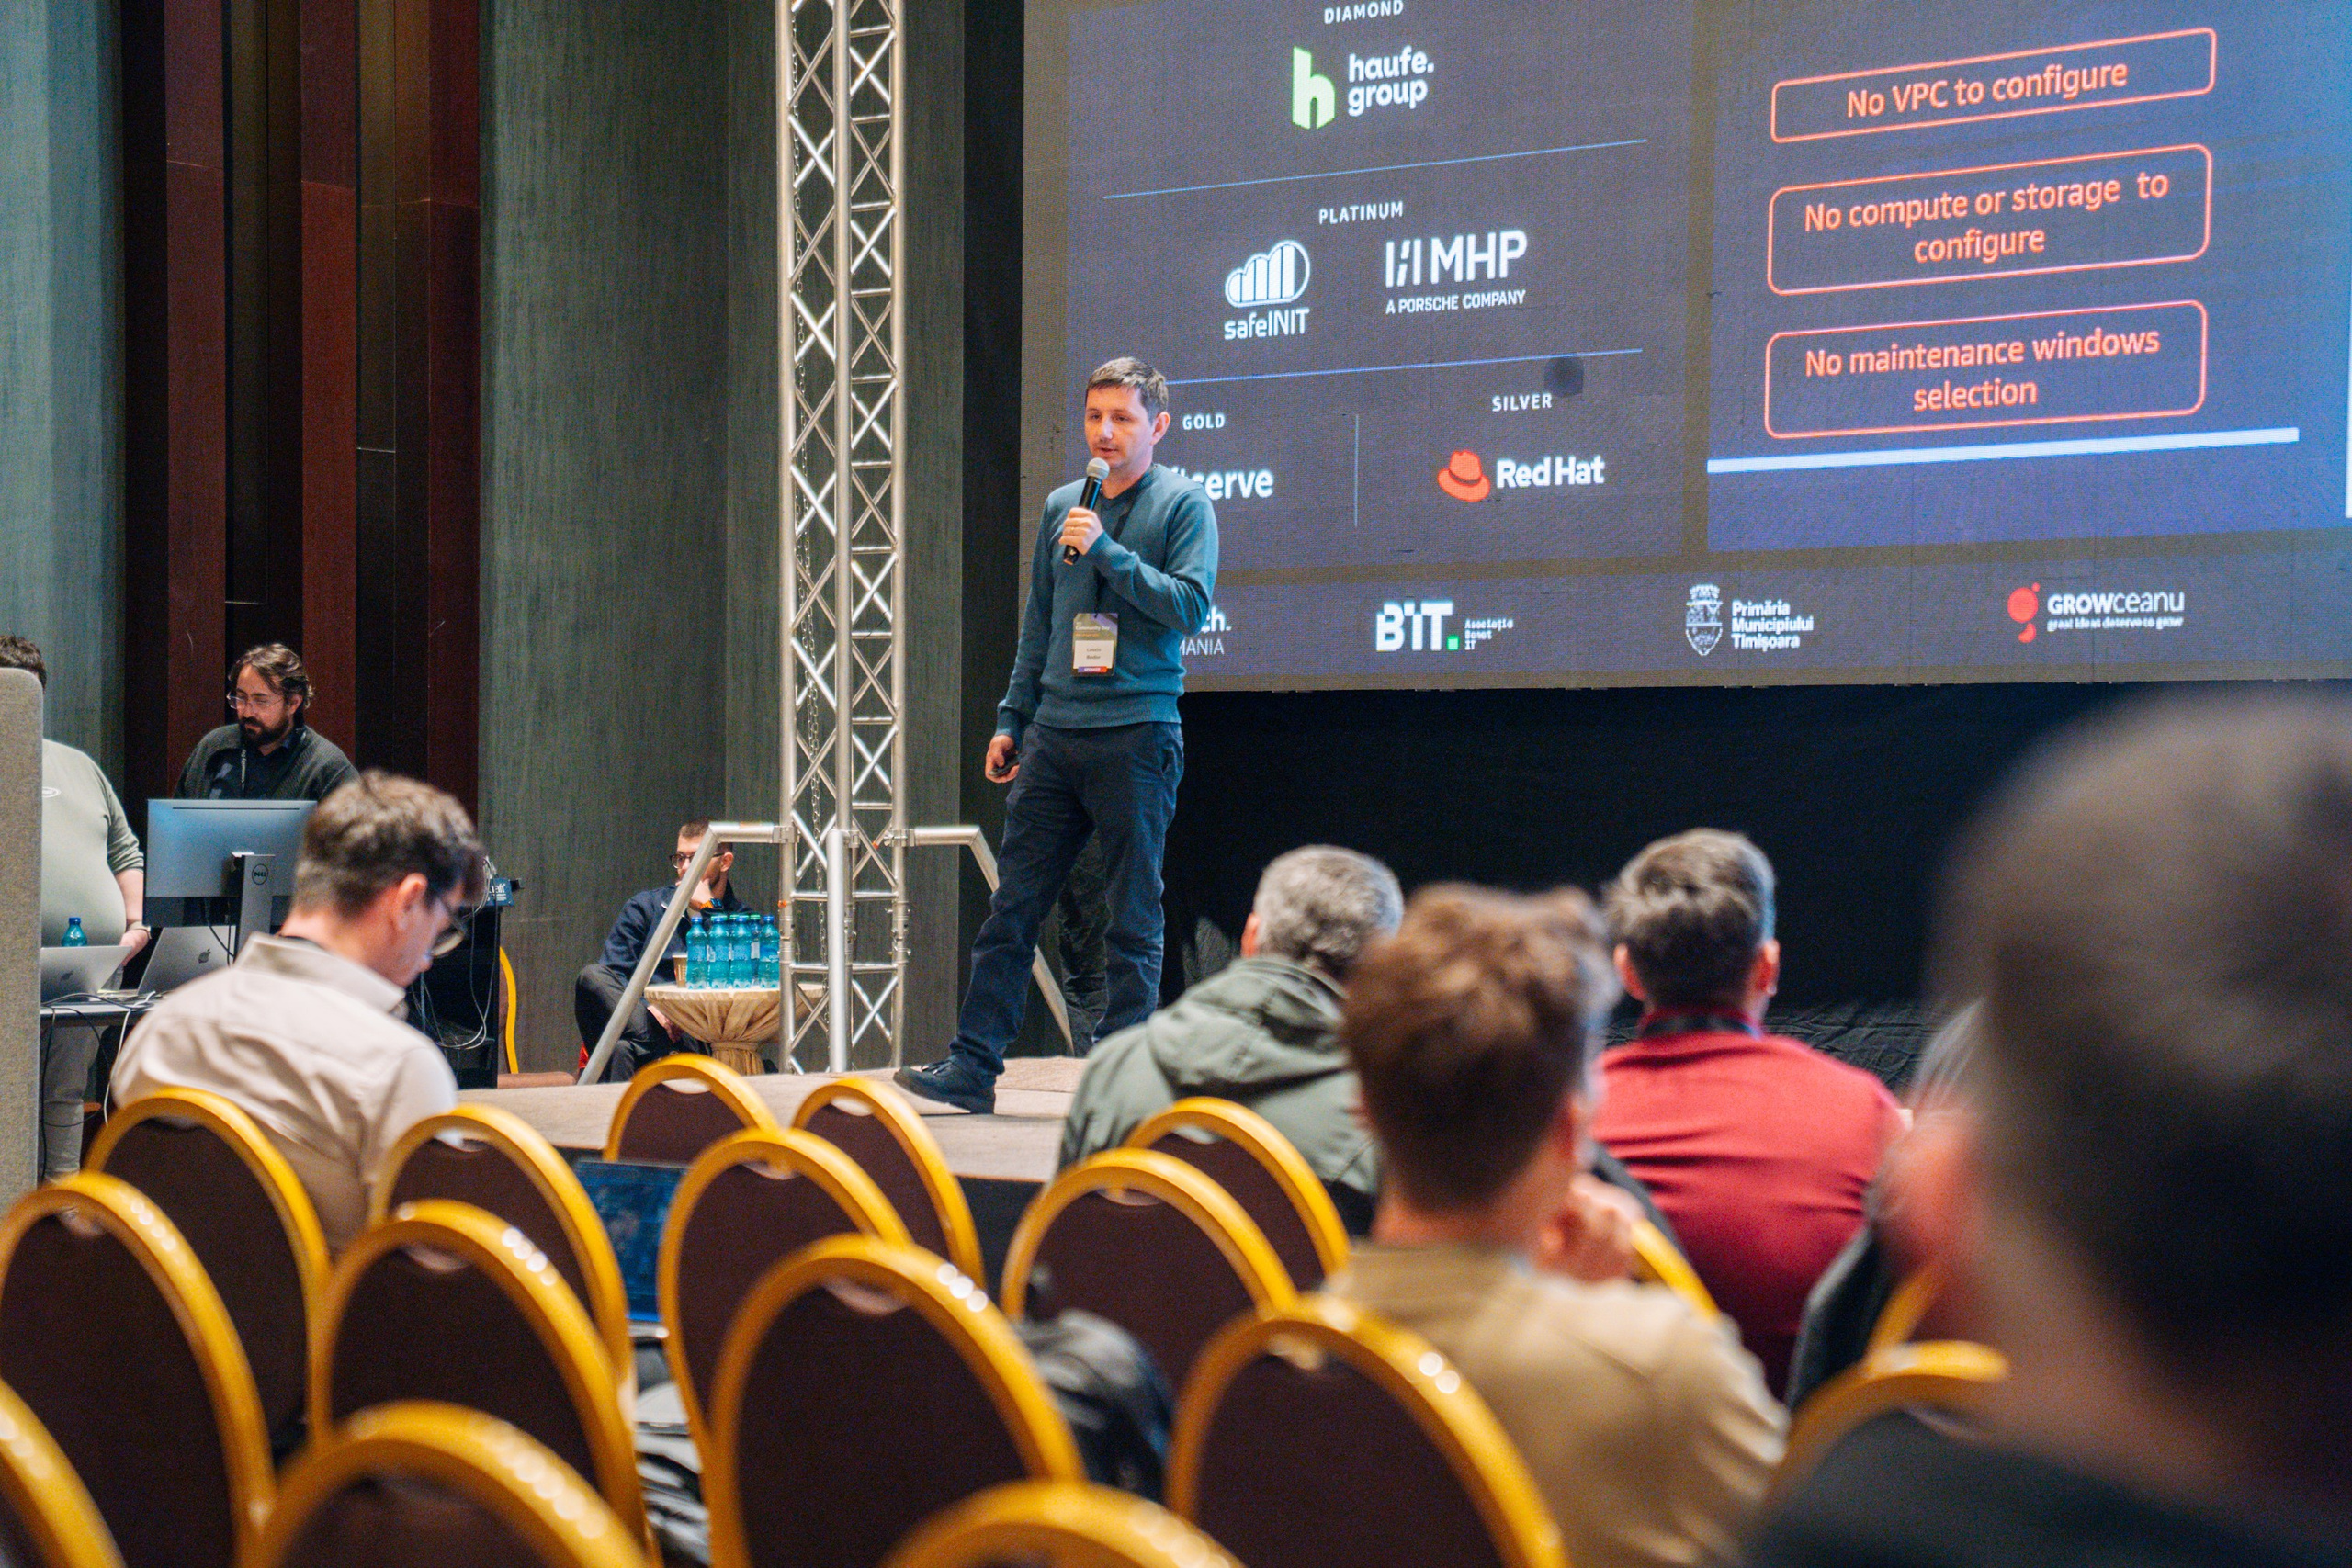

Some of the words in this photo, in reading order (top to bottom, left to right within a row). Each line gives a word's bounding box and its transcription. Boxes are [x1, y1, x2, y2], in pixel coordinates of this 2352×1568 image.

[1324, 0, 1404, 24] DIAMOND
[1348, 45, 1435, 83] haufe.
[1348, 79, 1429, 118] group
[1848, 89, 1886, 118] No
[1892, 79, 1949, 113] VPC
[1954, 78, 1985, 105] to
[1992, 63, 2129, 101] configure
[1318, 200, 1404, 225] PLATINUM
[1804, 203, 1842, 231] No
[1848, 191, 1969, 229] compute
[1974, 188, 2007, 216] or
[2011, 178, 2121, 212] storage
[2137, 171, 2170, 199] to
[1430, 229, 1529, 285] MHP
[1914, 227, 2046, 264] configure
[1385, 299, 1396, 315] A
[1398, 295, 1460, 314] PORSCHE
[1463, 289, 1527, 310] COMPANY
[1224, 306, 1311, 341] safeINIT
[1805, 349, 1842, 378] No
[1849, 340, 2025, 374] maintenance
[2031, 326, 2162, 361] windows
[1491, 392, 1553, 412] SILVER
[1913, 378, 2039, 412] selection
[1182, 413, 1226, 431] GOLD
[1496, 455, 1552, 489] Red
[1554, 454, 1606, 486] Hat
[2046, 590, 2186, 615] GROWceanu
[1731, 615, 1815, 635] Municipiului
